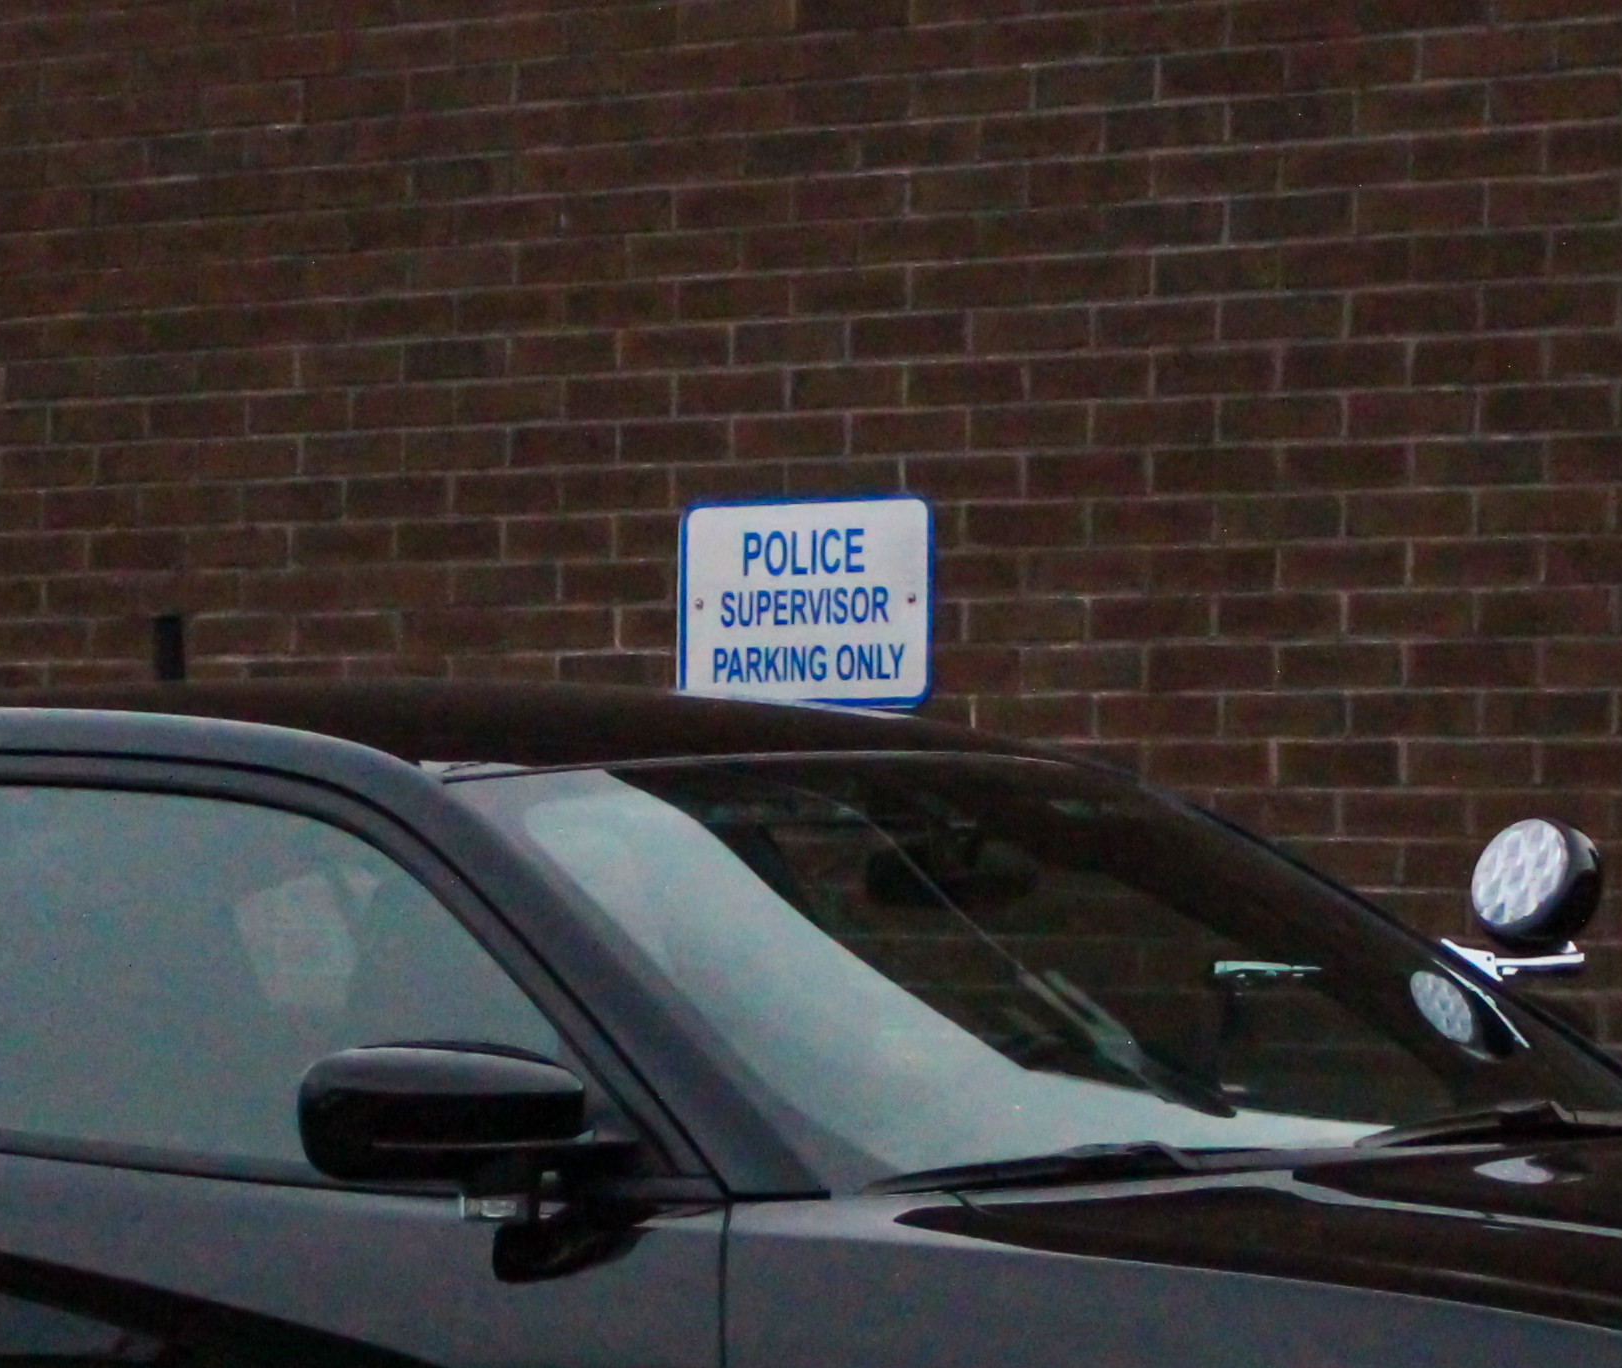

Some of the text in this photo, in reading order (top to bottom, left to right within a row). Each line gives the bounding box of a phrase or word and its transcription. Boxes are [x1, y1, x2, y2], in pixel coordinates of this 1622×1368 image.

[743, 528, 865, 576] POLICE
[720, 586, 889, 627] SUPERVISOR
[712, 643, 905, 683] PARKING ONLY
